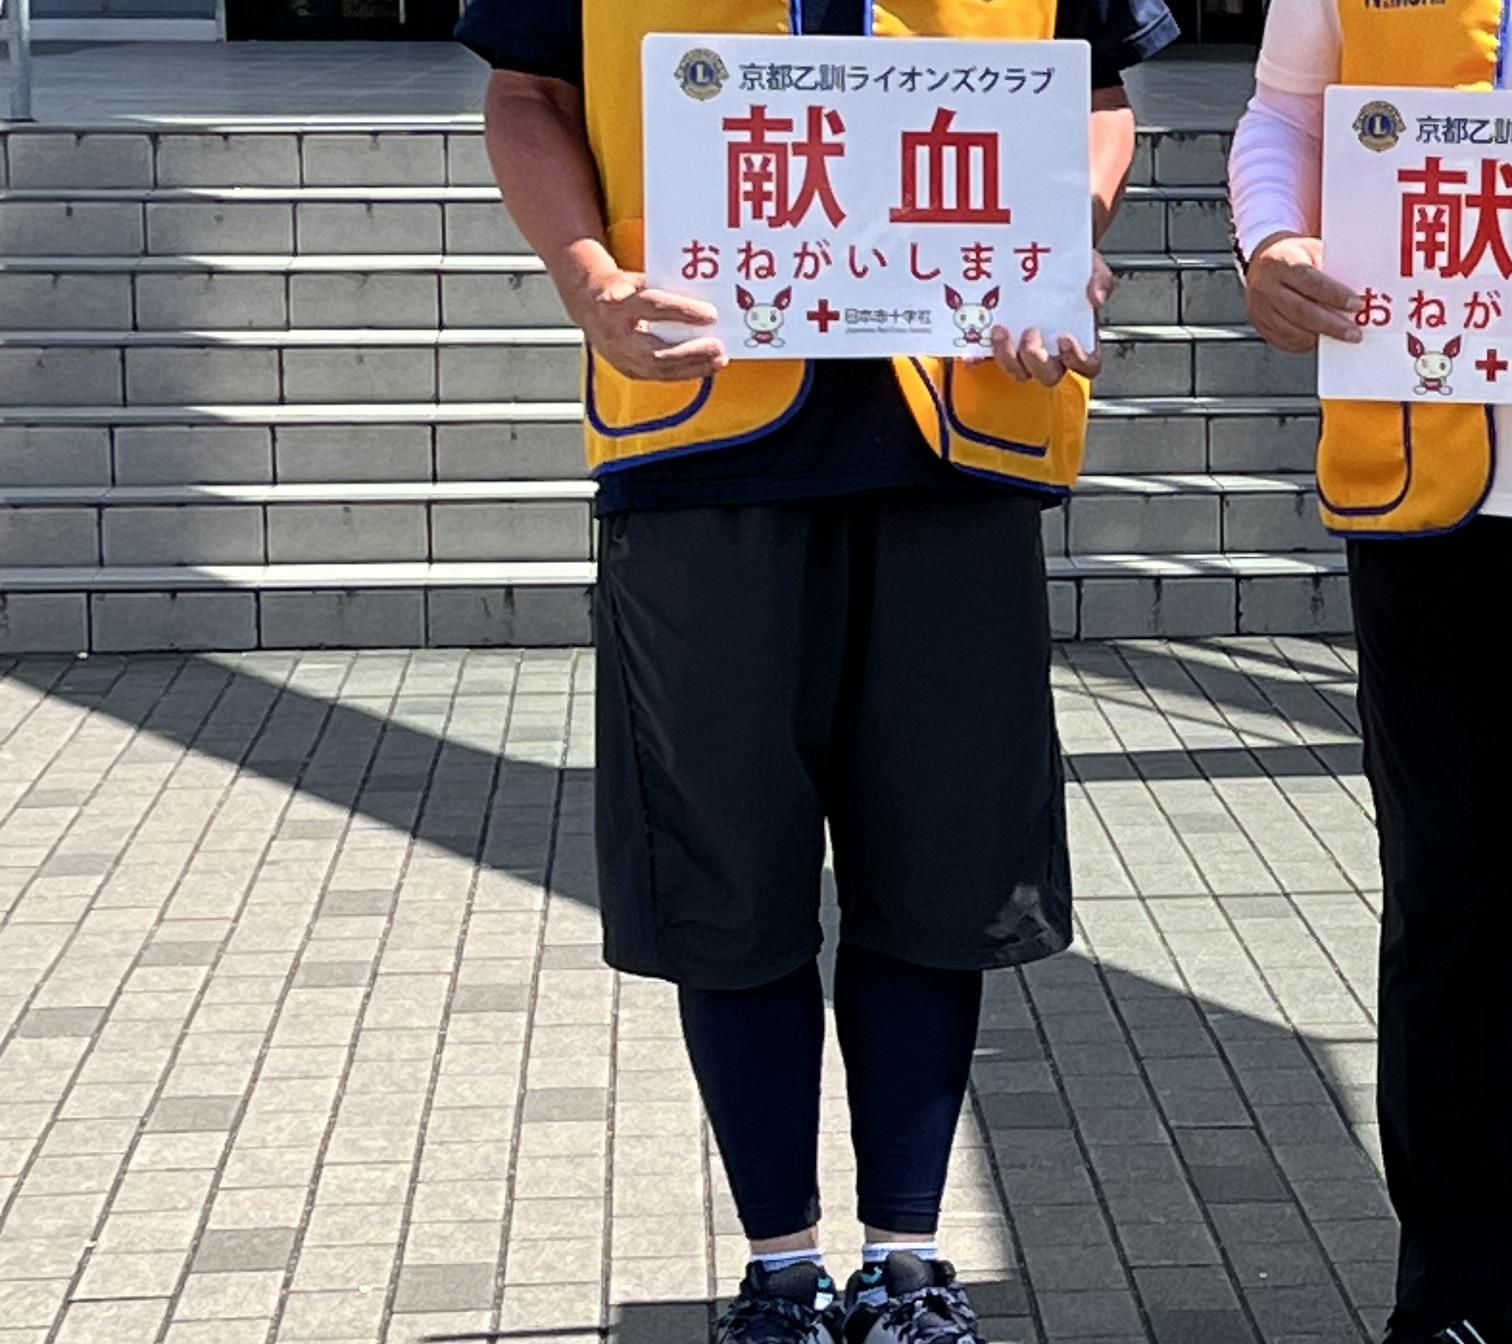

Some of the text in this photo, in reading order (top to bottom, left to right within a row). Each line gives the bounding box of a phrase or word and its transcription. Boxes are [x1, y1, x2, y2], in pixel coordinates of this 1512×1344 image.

[738, 63, 1055, 93] 京都乙訓ライオンズクラブ
[722, 105, 1011, 228] 献血
[681, 240, 1052, 282] おねがいします
